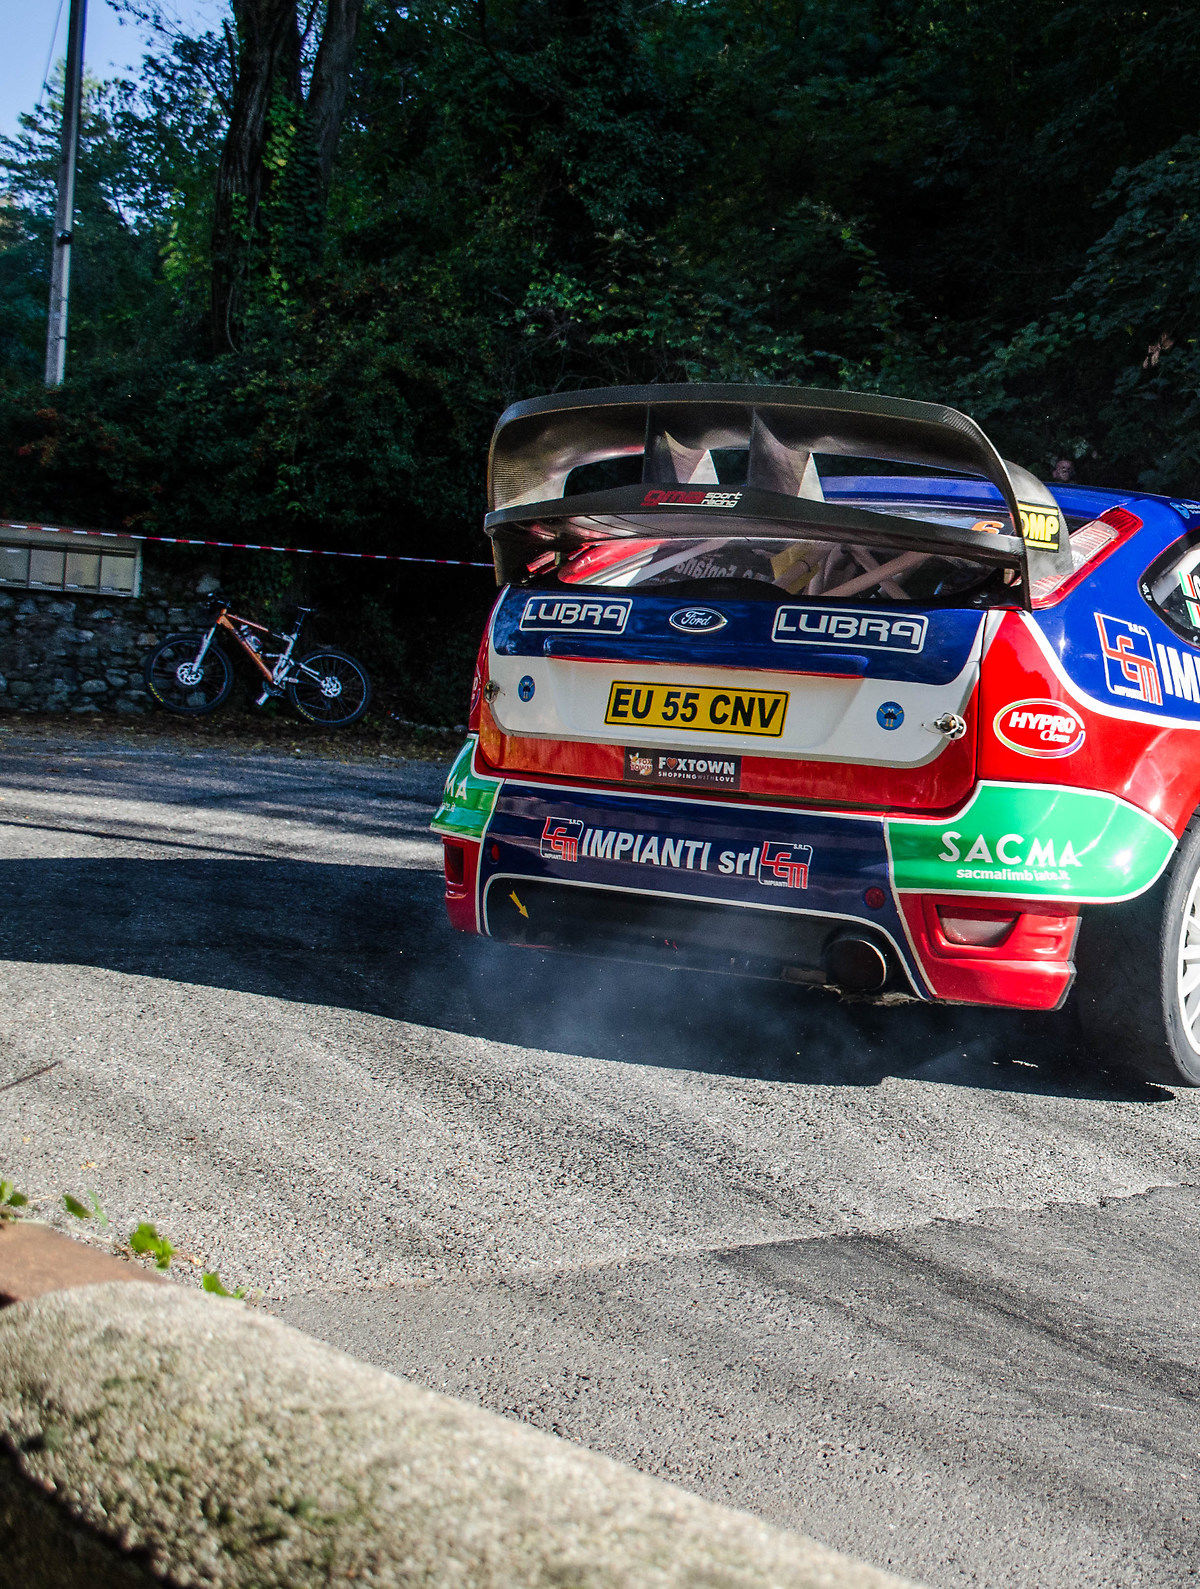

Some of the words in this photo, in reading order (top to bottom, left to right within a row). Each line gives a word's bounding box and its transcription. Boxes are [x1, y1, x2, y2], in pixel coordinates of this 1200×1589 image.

[705, 492, 742, 501] sport
[524, 603, 627, 627] LUBRA
[681, 611, 712, 626] Ford
[777, 613, 922, 645] LUBRA
[611, 688, 654, 719] EU
[661, 691, 700, 723] 55
[708, 694, 782, 728] CNV
[1009, 711, 1076, 734] HYPRO
[582, 828, 712, 872] IMPIANTI
[718, 846, 760, 877] srl
[937, 831, 1083, 868] SACMA
